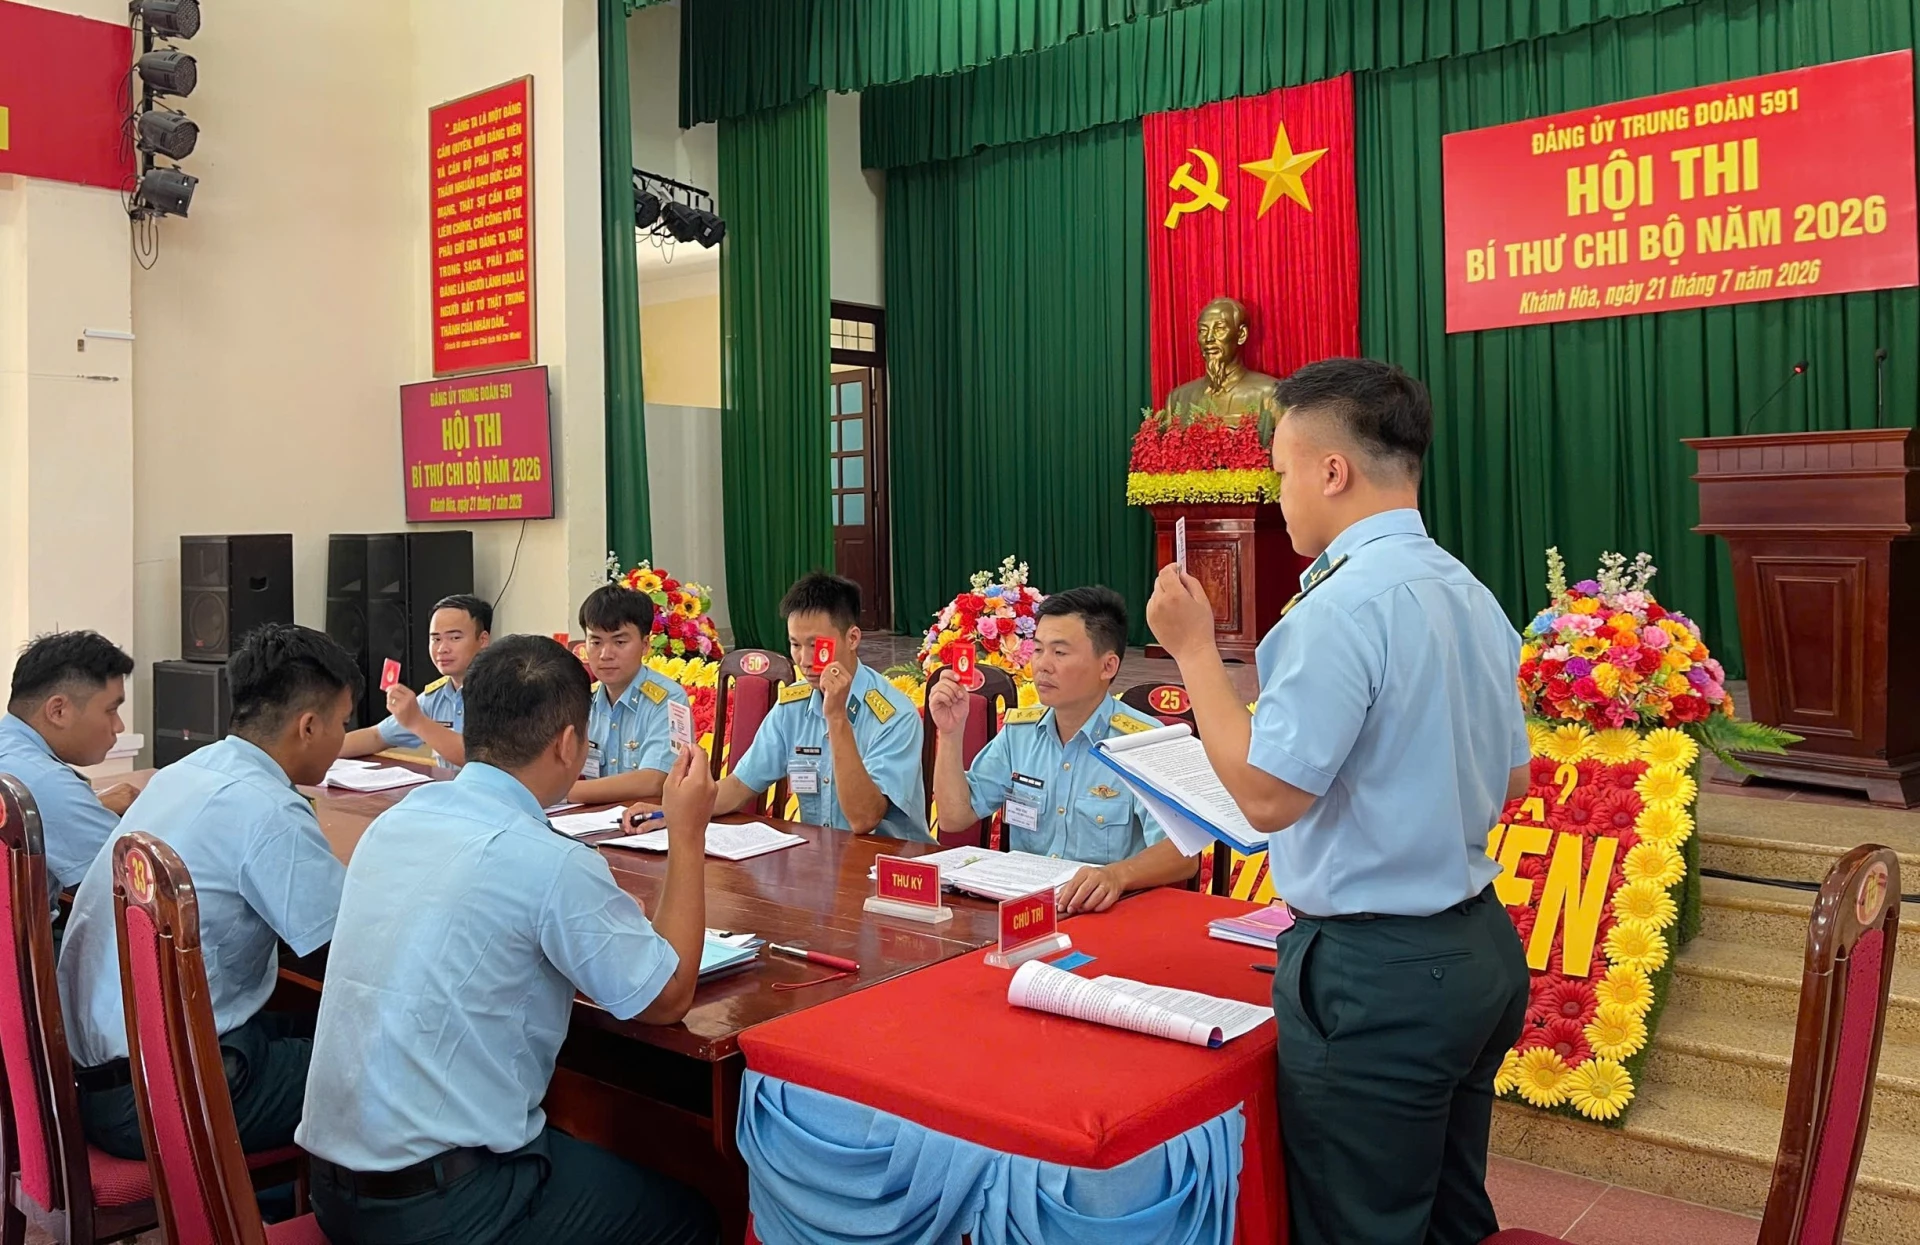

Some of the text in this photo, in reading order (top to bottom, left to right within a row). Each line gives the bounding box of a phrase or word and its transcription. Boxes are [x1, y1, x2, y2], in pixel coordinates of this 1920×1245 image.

[1532, 87, 1799, 155] ĐẢNG ỦY TRUNG ĐOÀN 591
[1566, 137, 1759, 221] HỘI THI
[1466, 194, 1887, 283] BÍ THƯ CHI BỘ NĂM 2026
[1519, 258, 1821, 315] Khánh Hòa, ngày 21 tháng 7 năm 2026
[430, 388, 447, 407] ĐẢNG
[458, 387, 479, 404] TRUNG
[480, 382, 498, 401] ĐOÀN
[500, 383, 512, 399] 591
[442, 409, 502, 457] HỘI THI
[412, 455, 541, 490] BÍ THƯ CHI BỘ NĂM 2026
[748, 656, 762, 671] 50
[1160, 690, 1180, 710] 25
[132, 857, 145, 894] 33
[892, 873, 923, 890] THƯ KÝ
[1485, 763, 1619, 978] ỂN
[1013, 903, 1044, 931] CHỦ TRÌ
